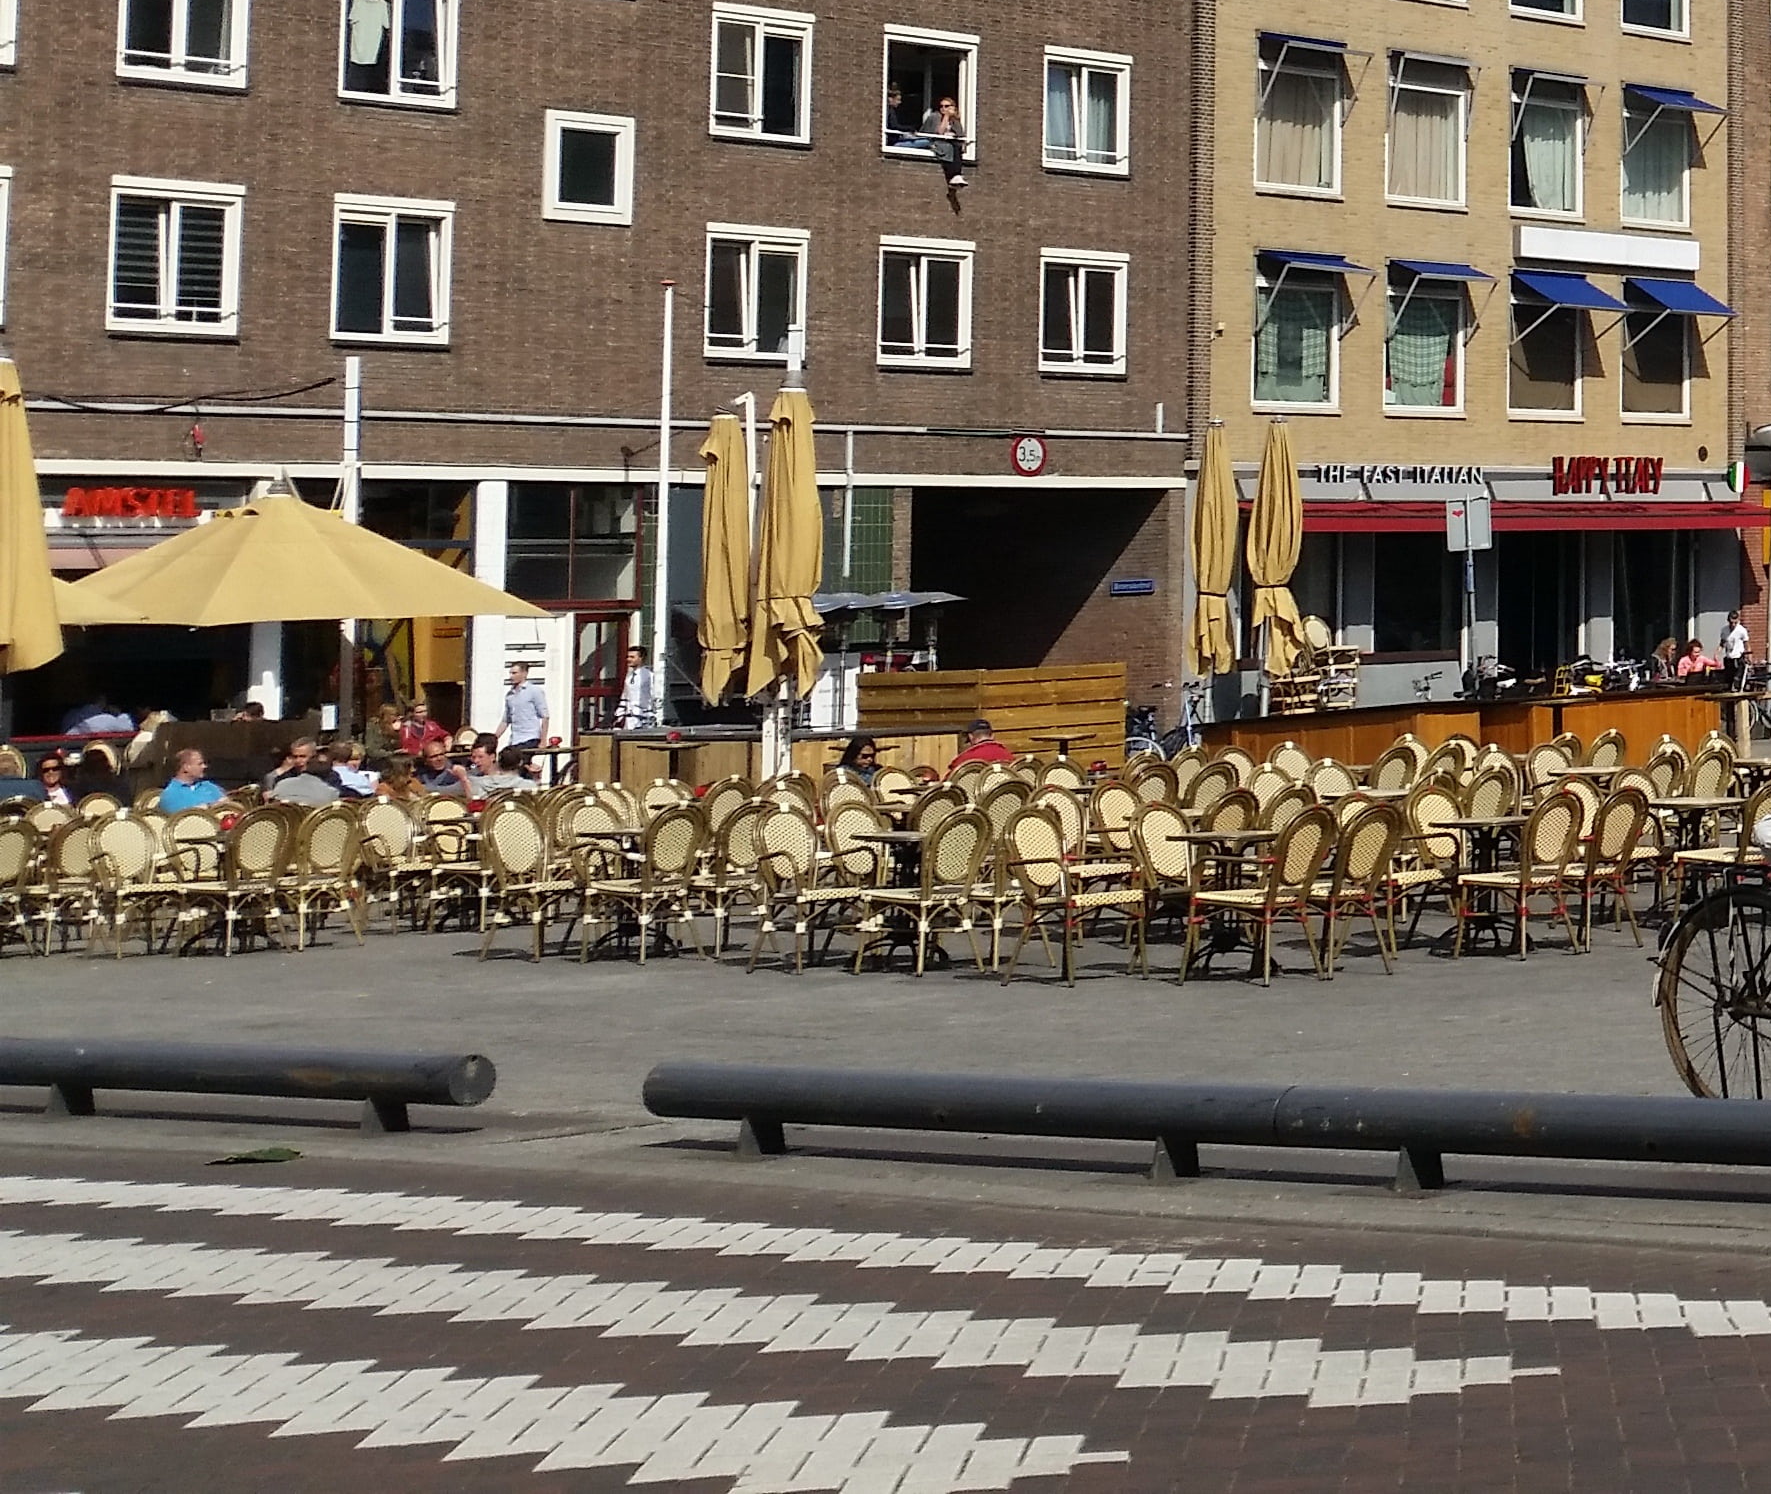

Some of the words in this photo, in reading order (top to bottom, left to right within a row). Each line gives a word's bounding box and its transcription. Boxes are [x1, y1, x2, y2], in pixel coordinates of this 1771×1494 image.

[1317, 465, 1351, 483] THE
[1362, 466, 1404, 484] FAST
[1414, 466, 1484, 484] ITALIAN
[1552, 457, 1609, 495] HAPPY
[1613, 457, 1663, 495] ITALY
[63, 487, 201, 518] AMSTEL
